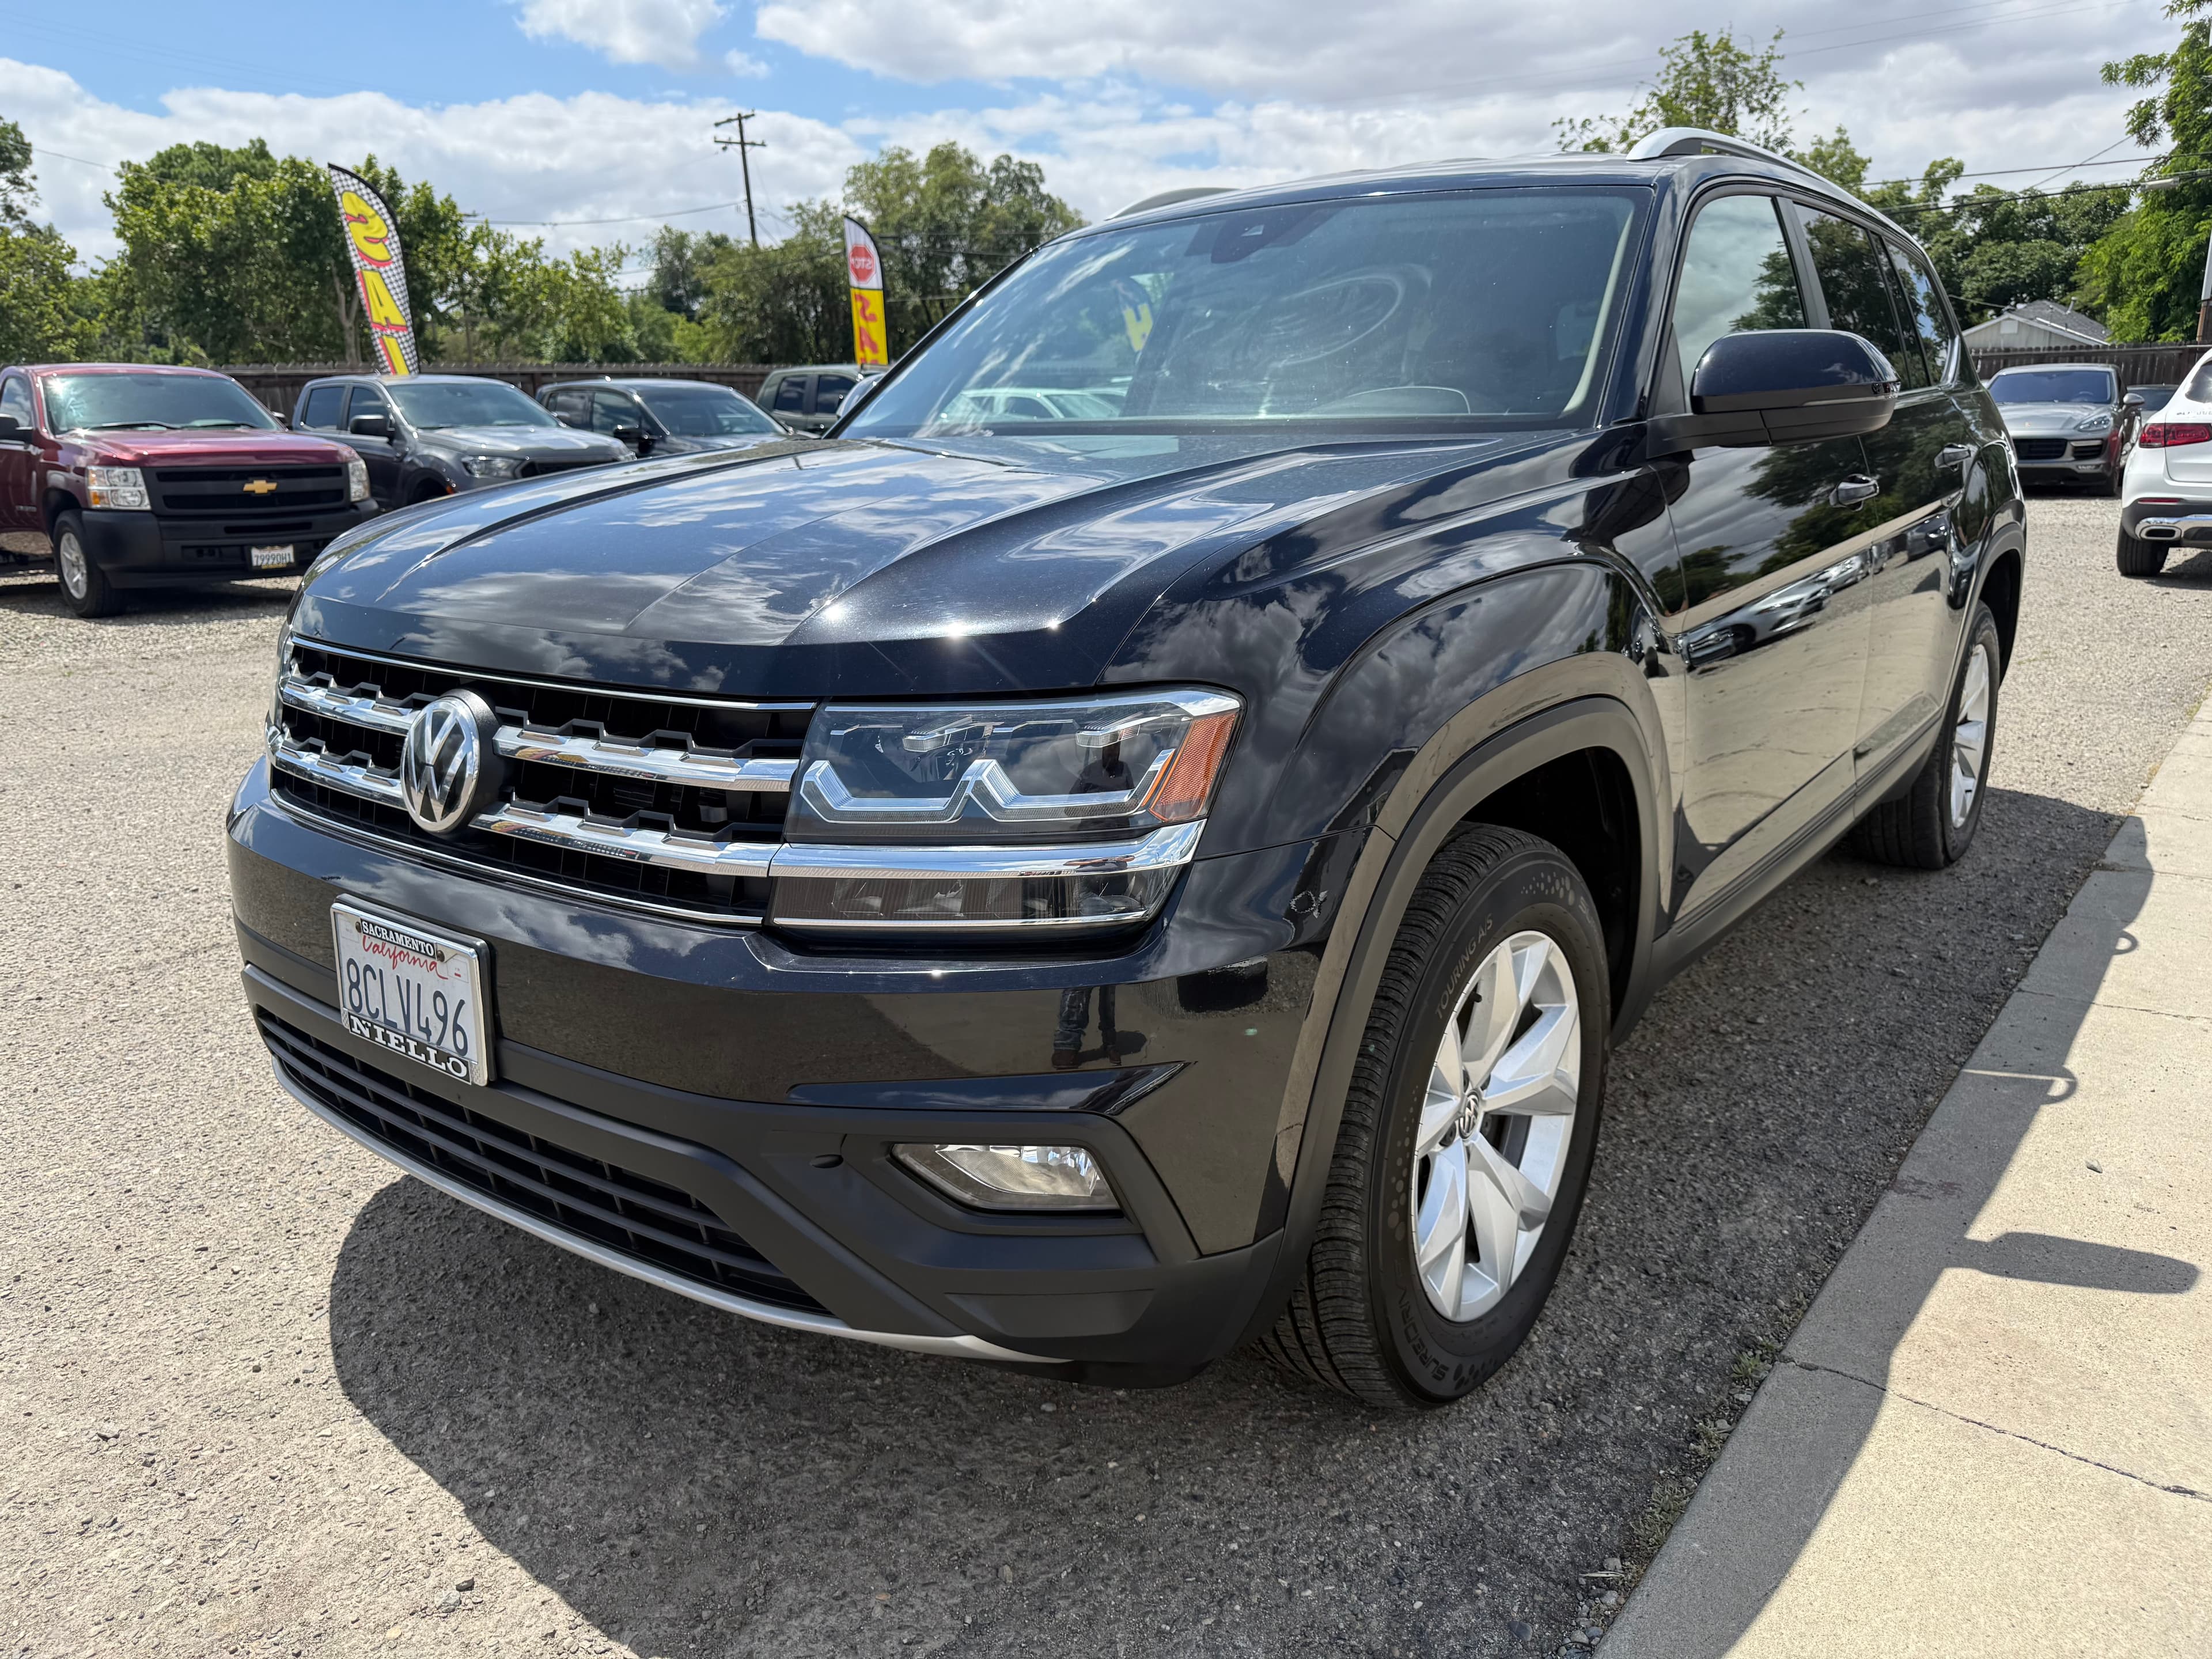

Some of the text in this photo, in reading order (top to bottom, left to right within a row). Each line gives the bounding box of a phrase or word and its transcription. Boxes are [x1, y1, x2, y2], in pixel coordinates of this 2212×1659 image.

[362, 921, 435, 956] SACRAMENTO
[362, 935, 448, 980] California
[1435, 913, 1493, 1019] TOURING A/S
[347, 957, 468, 1056] 8CLV496
[350, 1016, 467, 1078] NIELLO
